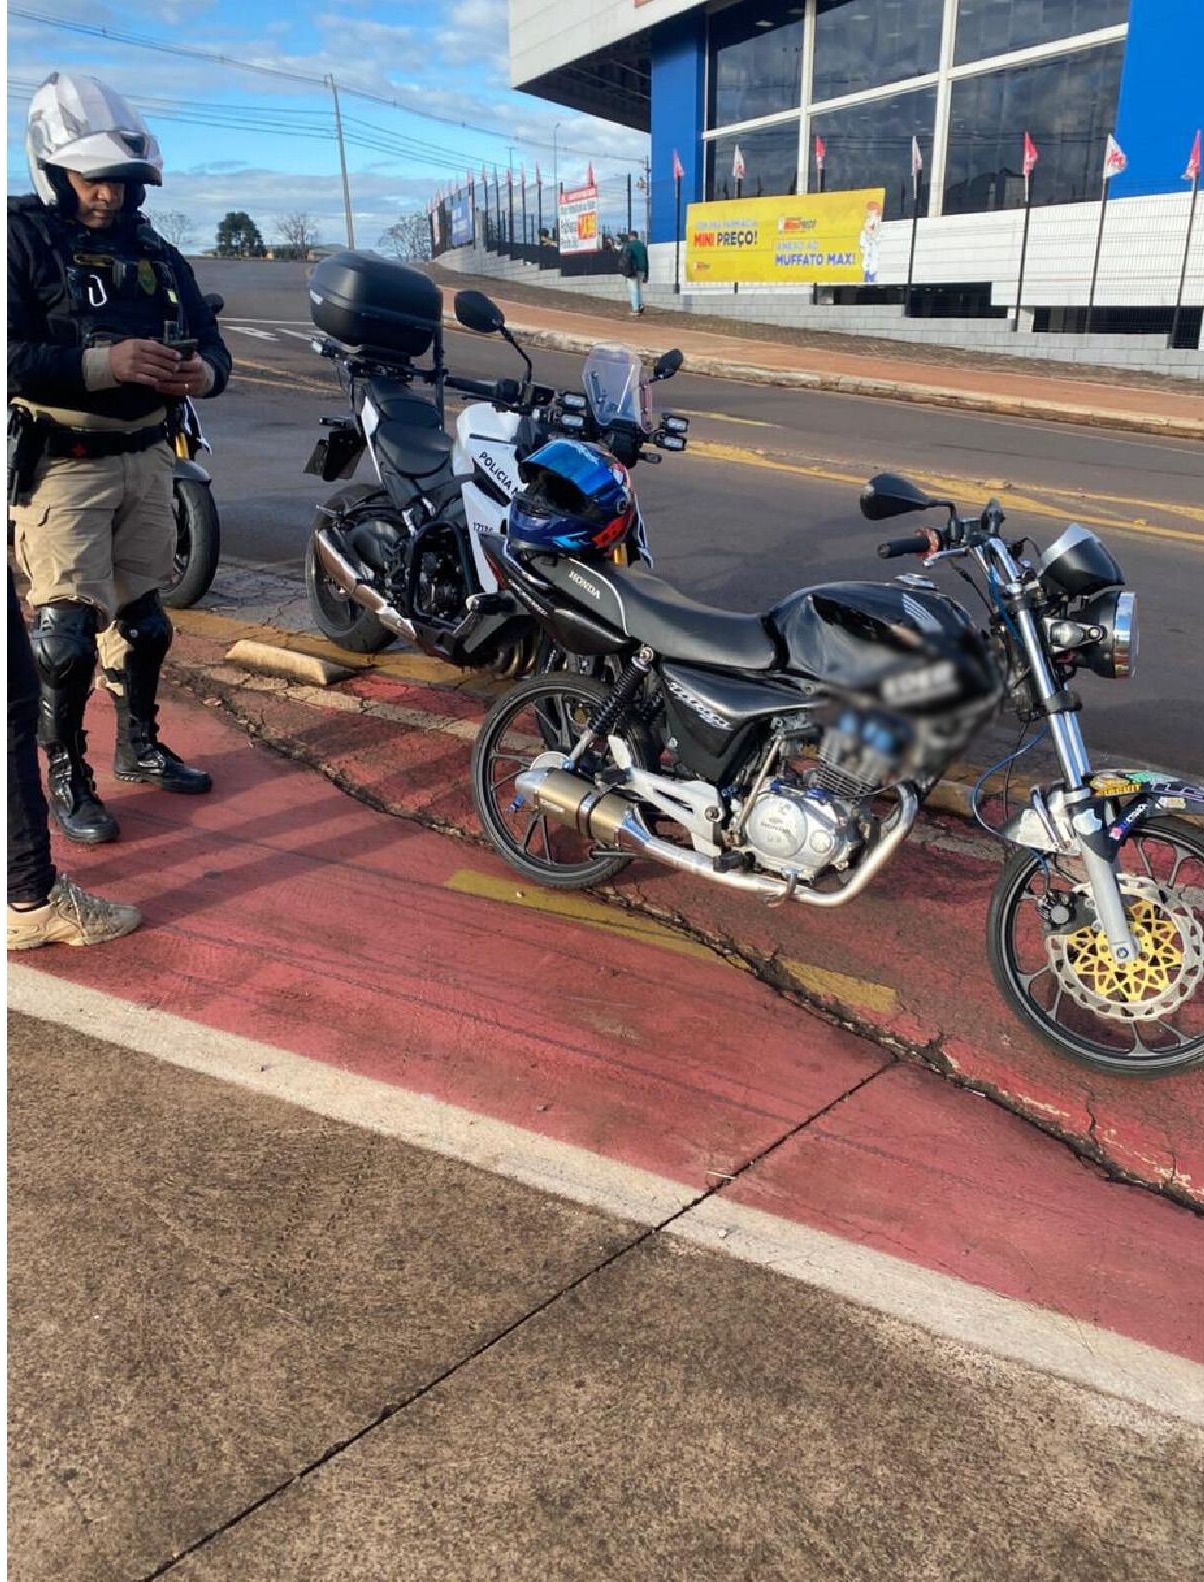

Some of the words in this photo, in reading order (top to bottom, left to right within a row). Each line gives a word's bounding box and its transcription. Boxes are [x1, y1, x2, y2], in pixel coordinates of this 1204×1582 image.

[716, 230, 757, 249] PREÇO!
[775, 253, 823, 267] MUFFATO
[568, 570, 601, 600] HONDA
